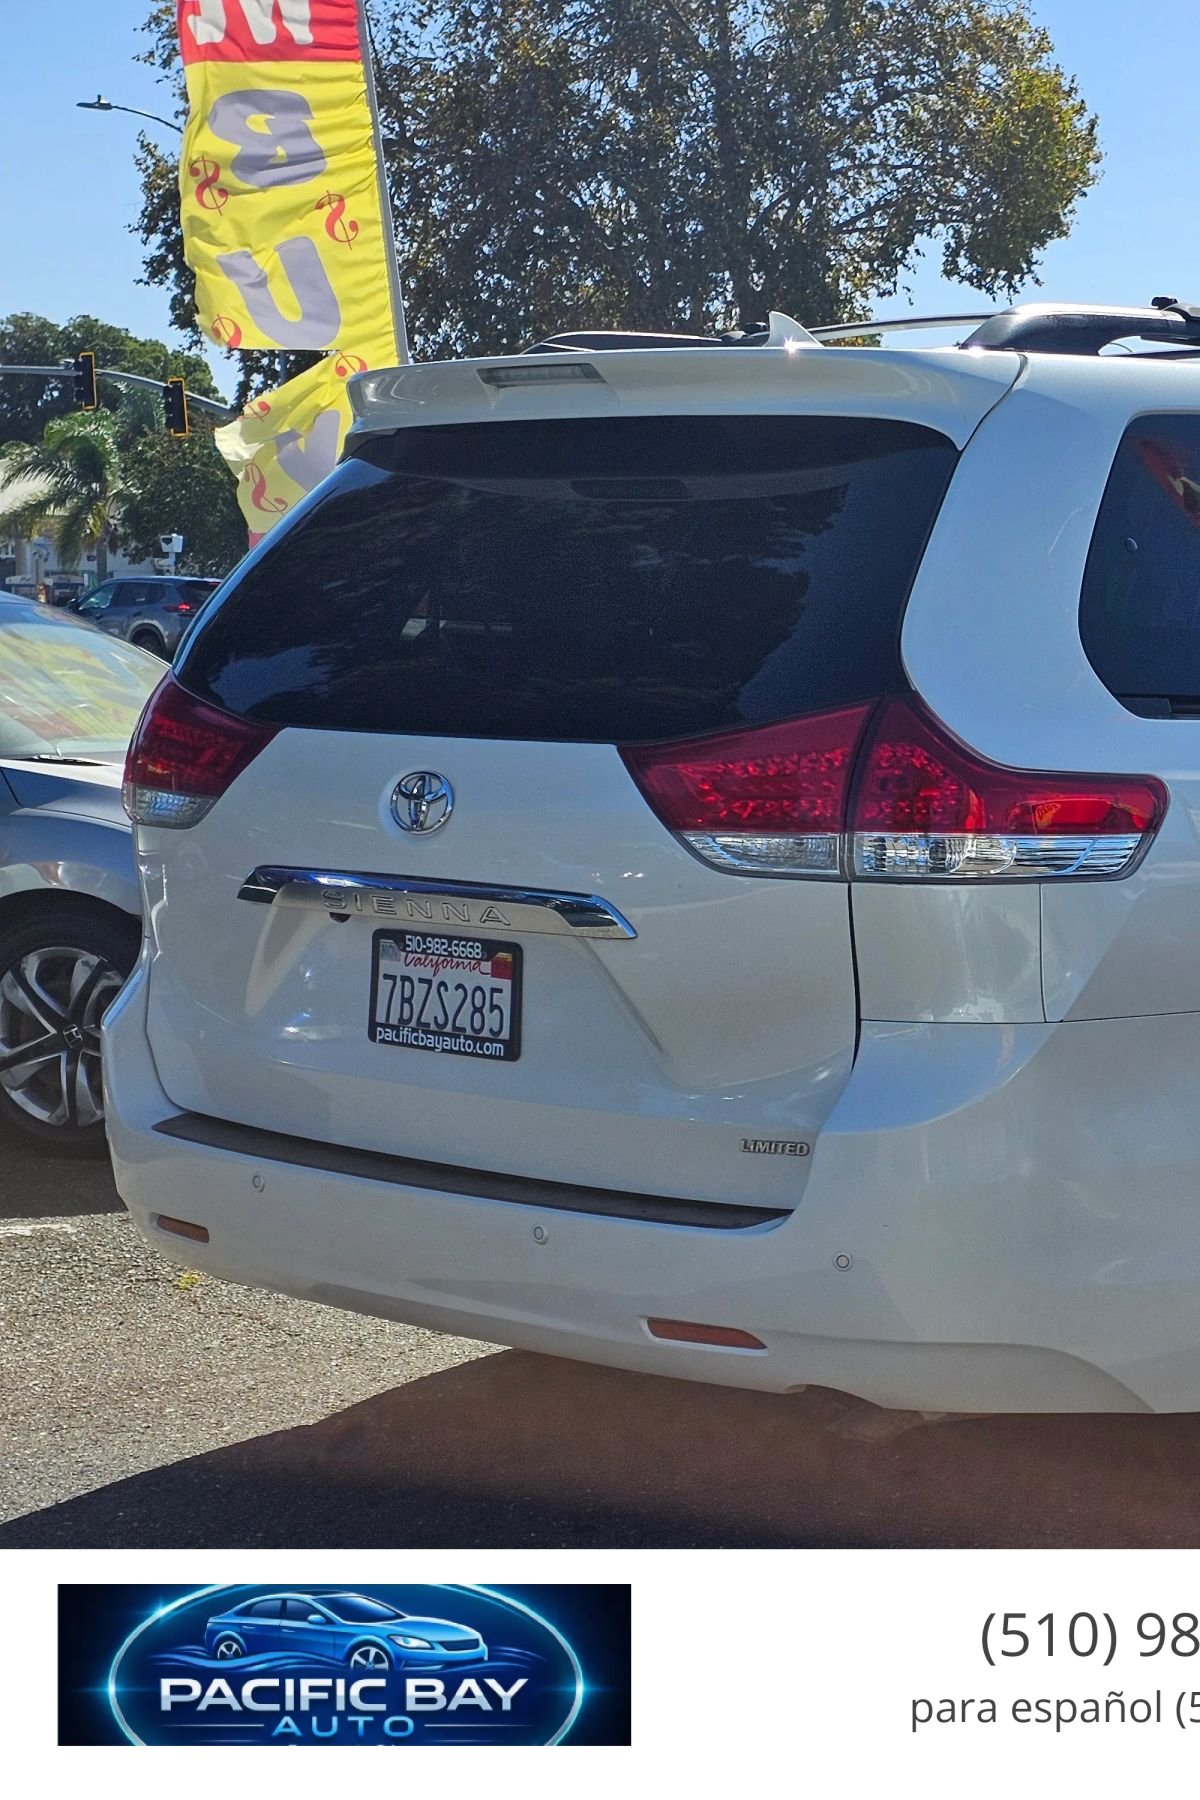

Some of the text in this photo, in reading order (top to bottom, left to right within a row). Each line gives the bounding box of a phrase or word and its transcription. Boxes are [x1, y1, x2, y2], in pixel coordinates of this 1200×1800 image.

[322, 890, 511, 925] SIENNA
[405, 935, 482, 958] 510-982-6668
[403, 952, 491, 977] California
[382, 973, 505, 1038] 7BZS285
[376, 1027, 505, 1057] pacificbayauto.com
[740, 1139, 810, 1156] LIMITED
